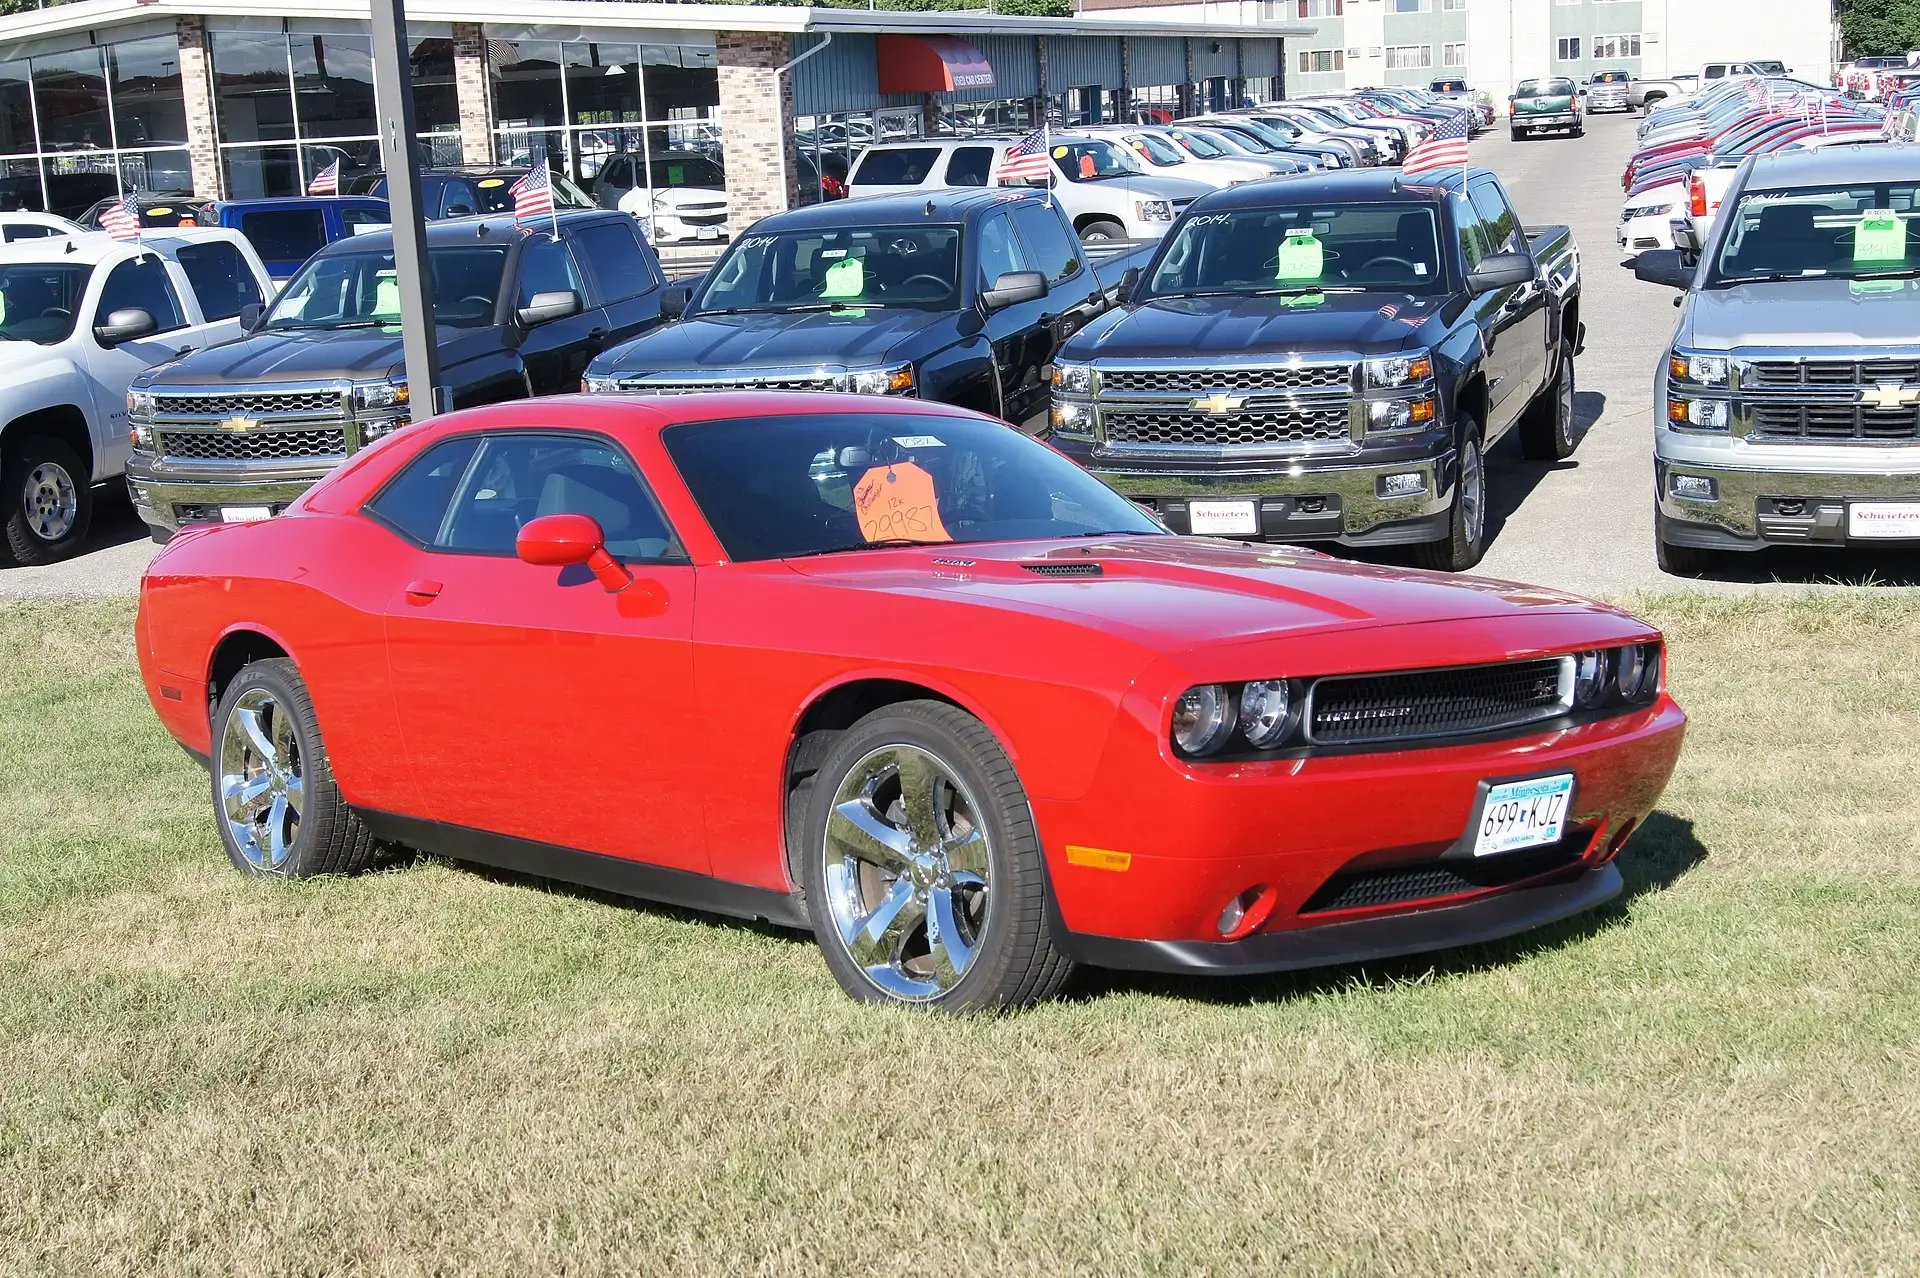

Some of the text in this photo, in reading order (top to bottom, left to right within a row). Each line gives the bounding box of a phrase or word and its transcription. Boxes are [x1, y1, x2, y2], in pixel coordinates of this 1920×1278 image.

[1856, 511, 1920, 520] Schwieters
[1510, 785, 1550, 797] Minnesota
[1484, 794, 1564, 837] 699 KJZ
